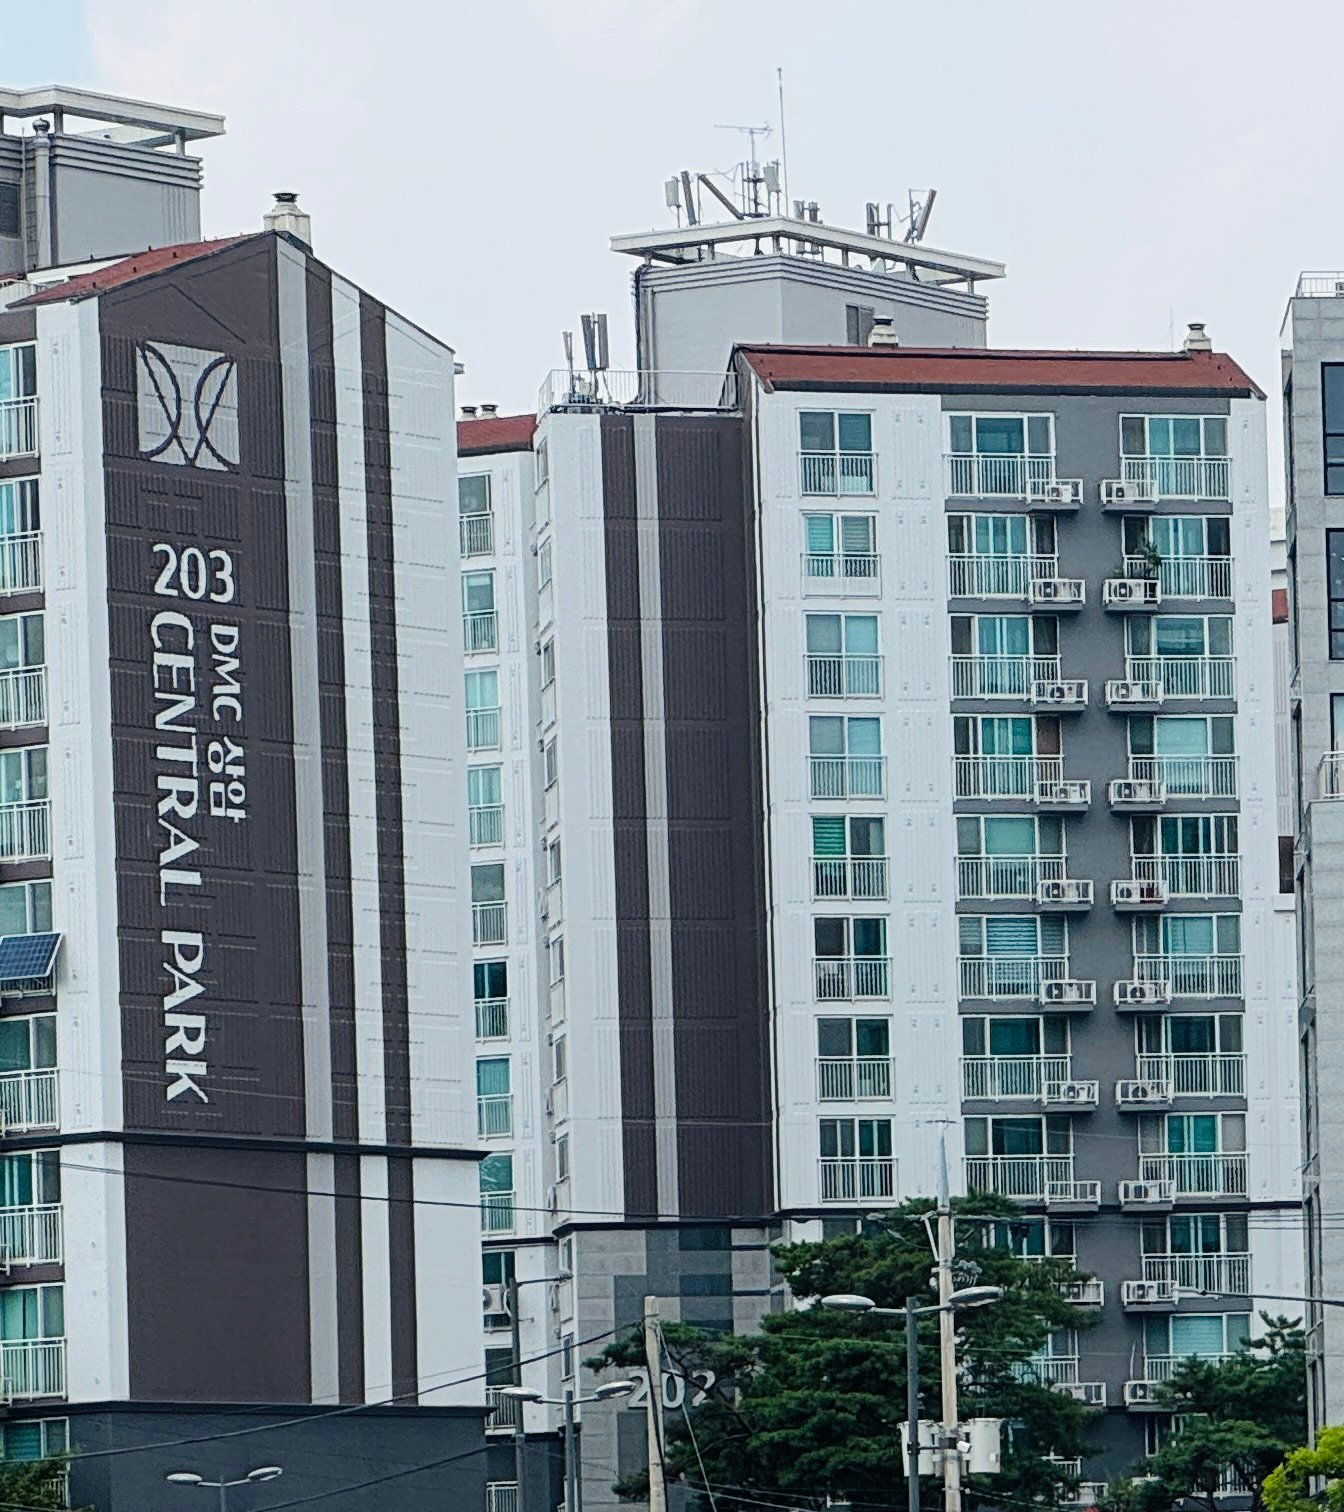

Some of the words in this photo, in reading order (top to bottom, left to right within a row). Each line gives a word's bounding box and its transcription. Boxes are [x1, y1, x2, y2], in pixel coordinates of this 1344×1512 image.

[151, 543, 235, 603] 203
[210, 624, 242, 722] DMC
[150, 611, 202, 907] CENTRAL
[207, 735, 247, 824] 상암
[161, 930, 209, 1104] PARK
[627, 1368, 716, 1409] 202
